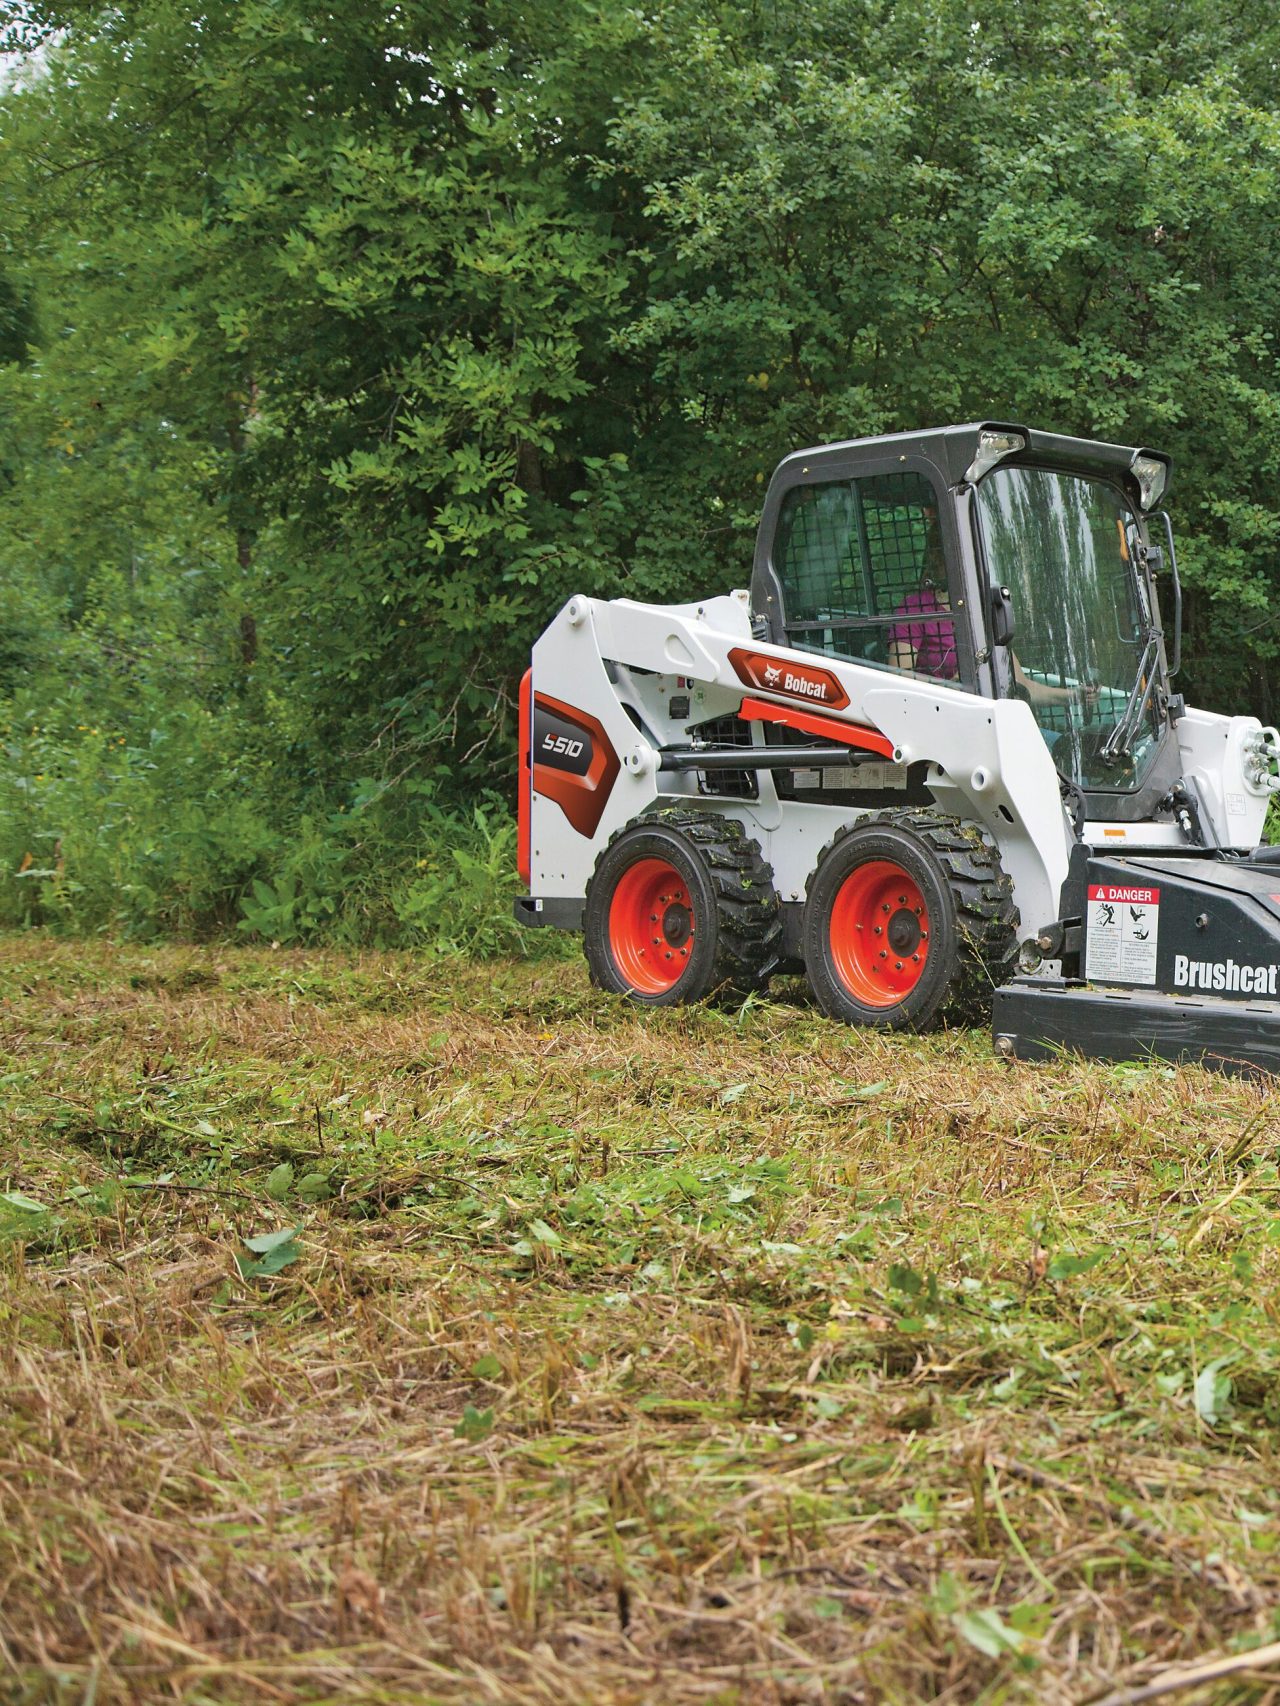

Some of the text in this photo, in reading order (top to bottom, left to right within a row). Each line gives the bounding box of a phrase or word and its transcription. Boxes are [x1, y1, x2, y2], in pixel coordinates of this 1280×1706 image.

[784, 673, 827, 699] Bobcat
[542, 733, 584, 758] S510
[1109, 888, 1152, 901] DANGER
